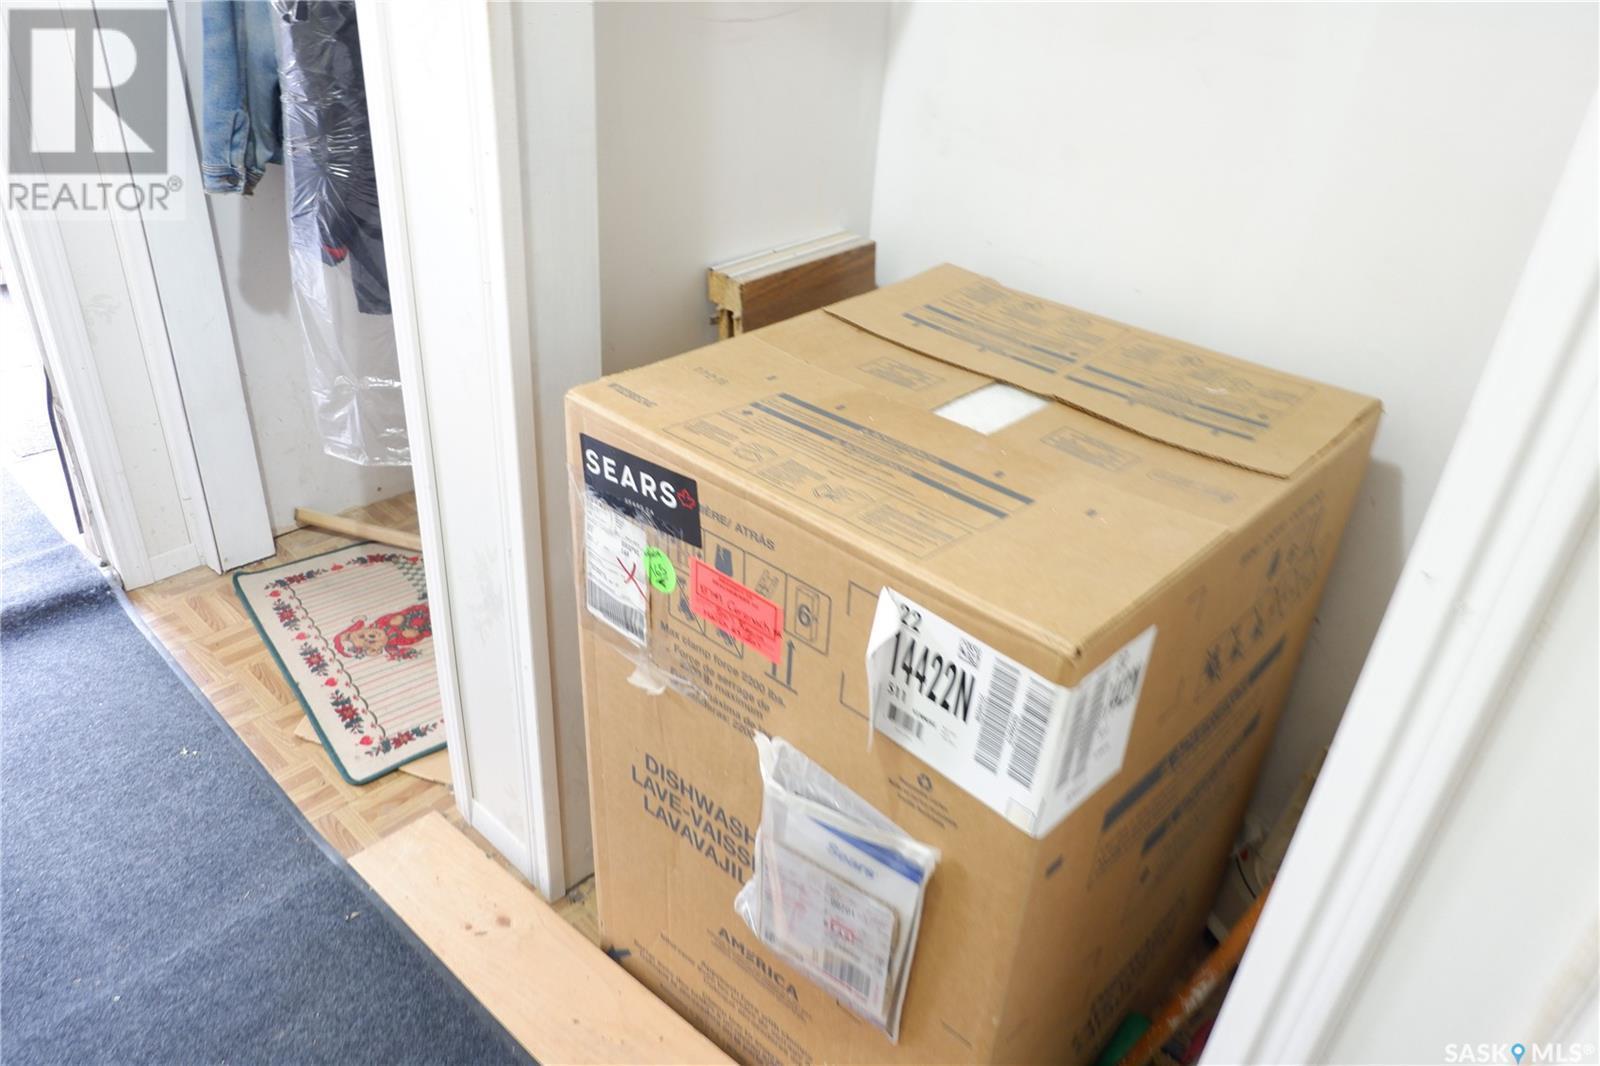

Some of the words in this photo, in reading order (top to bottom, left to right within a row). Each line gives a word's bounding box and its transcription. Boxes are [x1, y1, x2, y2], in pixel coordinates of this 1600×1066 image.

[584, 448, 678, 509] SEARS
[798, 603, 812, 628] 6
[900, 603, 922, 633] 22
[660, 619, 680, 641] Max
[682, 635, 712, 660] clamp
[713, 654, 739, 677] force
[741, 670, 766, 696] 2200
[891, 631, 976, 723] 14422N
[718, 927, 799, 1001] AMERICA
